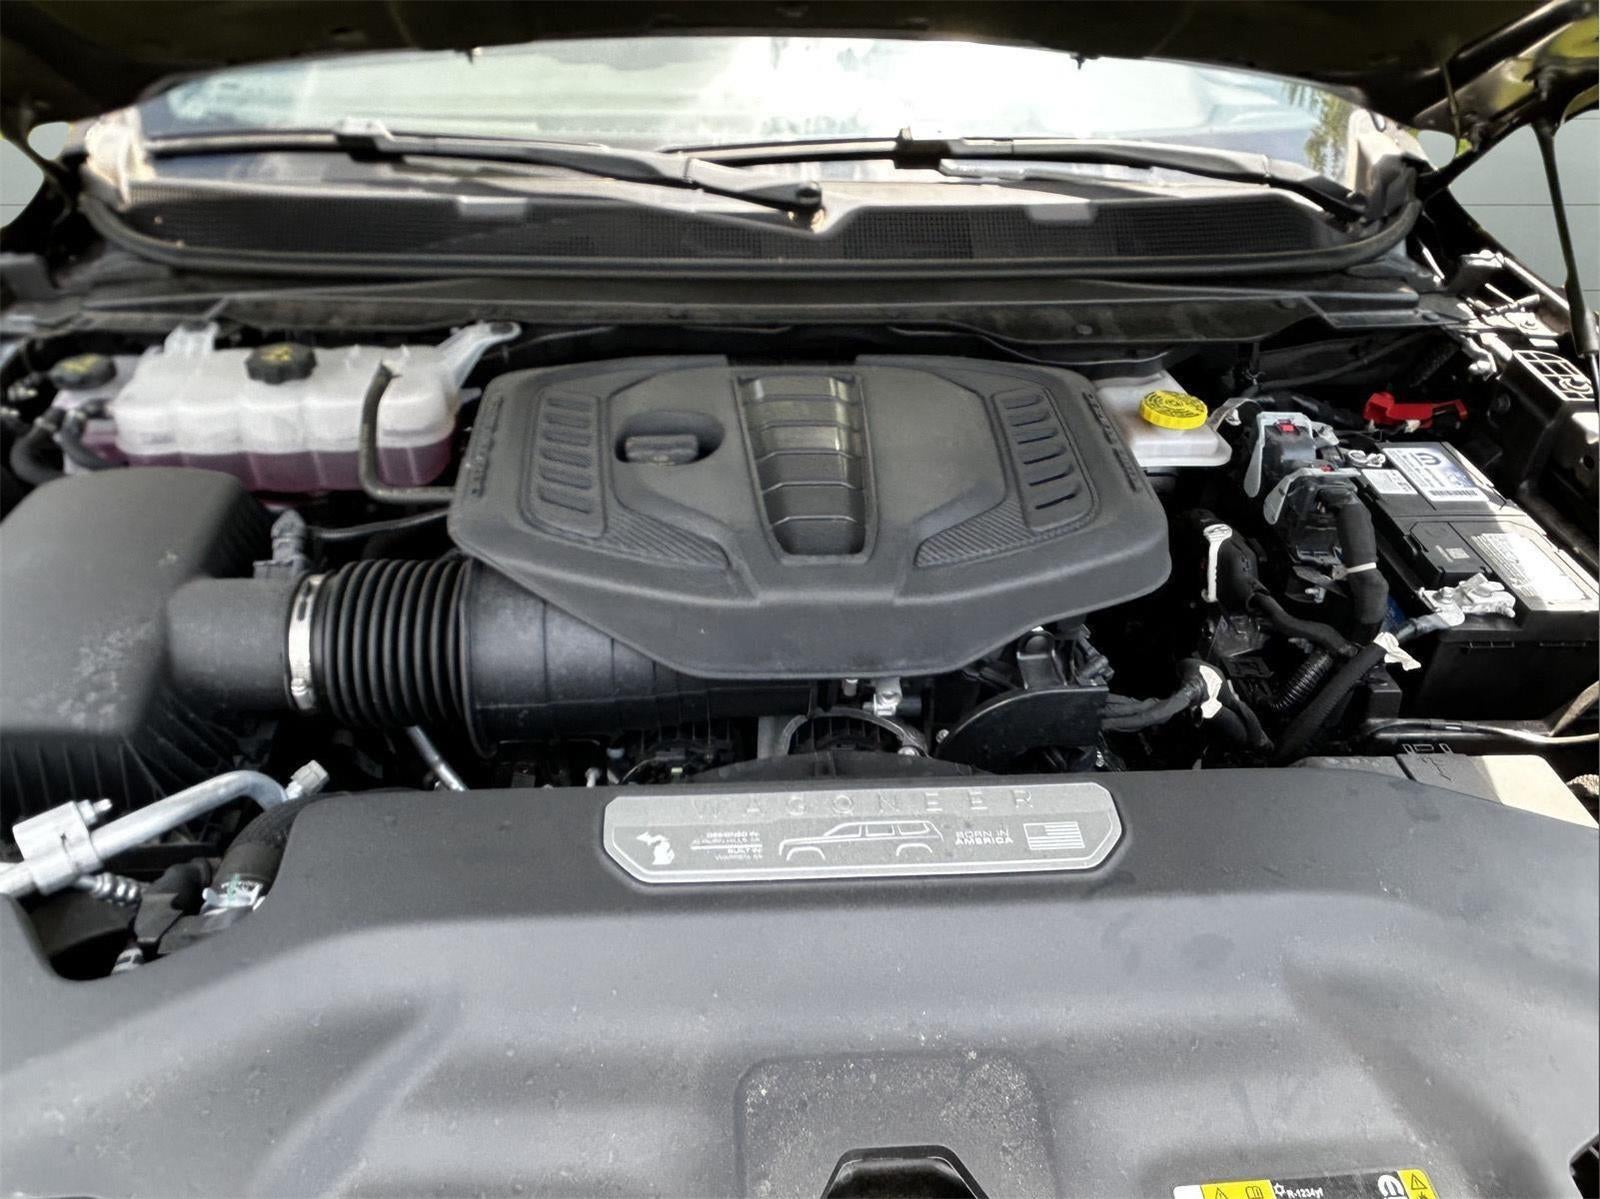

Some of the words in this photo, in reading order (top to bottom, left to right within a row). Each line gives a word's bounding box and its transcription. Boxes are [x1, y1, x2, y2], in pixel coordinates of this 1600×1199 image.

[691, 788, 1034, 819] WAGONEER
[955, 830, 992, 838] BORN
[954, 837, 1014, 845] AMERICA
